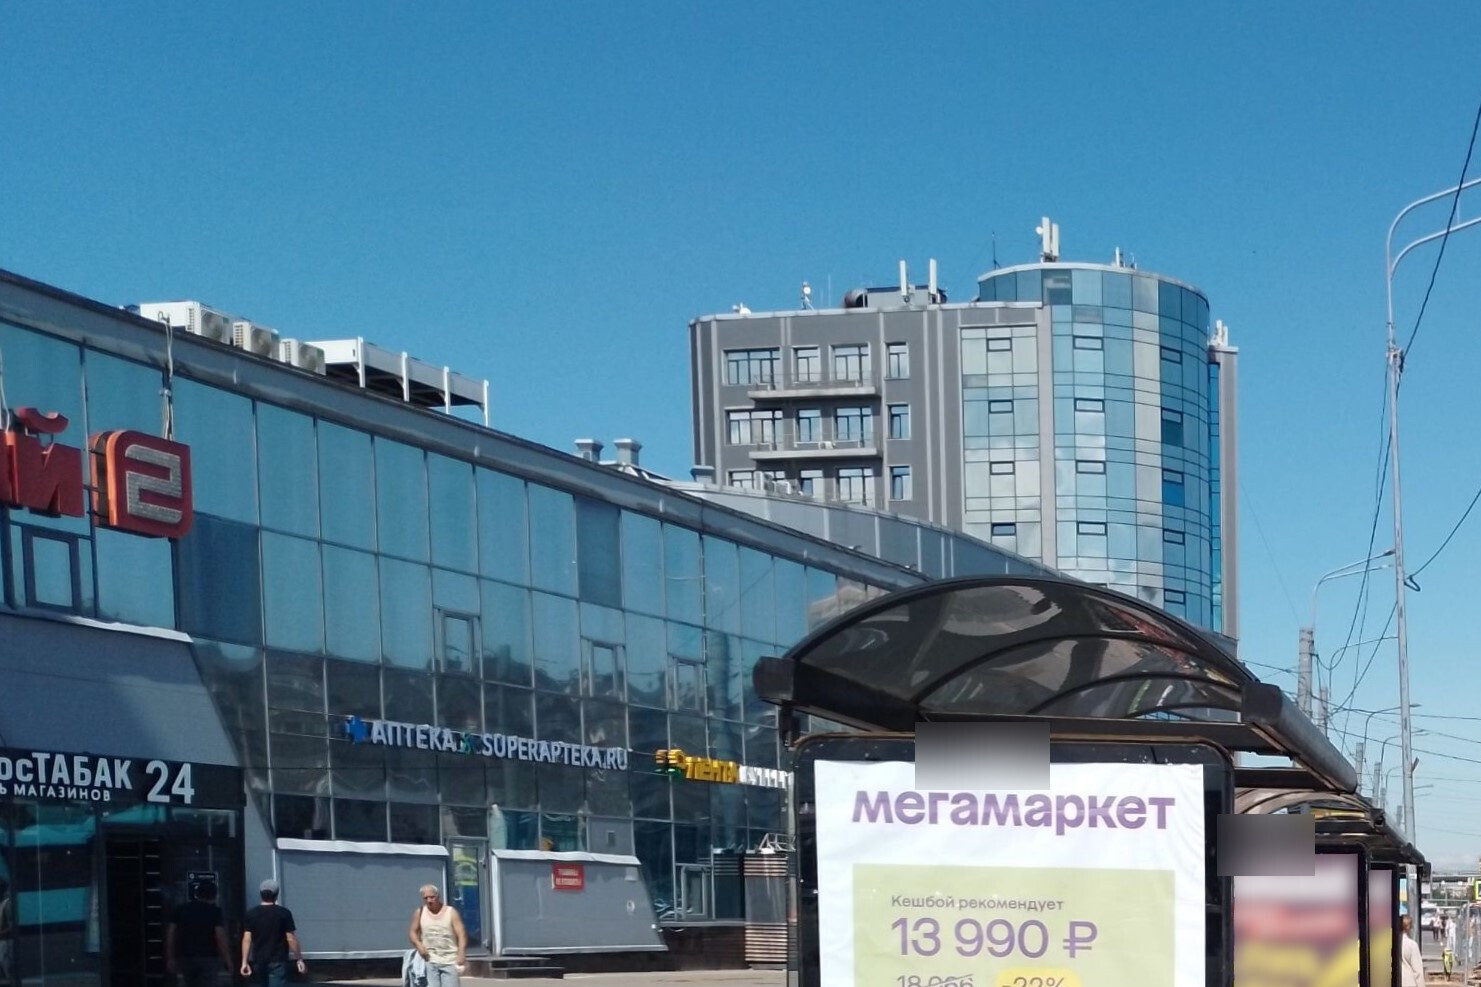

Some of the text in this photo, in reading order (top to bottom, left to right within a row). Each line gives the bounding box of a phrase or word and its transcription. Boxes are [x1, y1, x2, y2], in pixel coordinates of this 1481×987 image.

[371, 720, 456, 752] АПТЕКА
[481, 733, 628, 771] SUPERAPTEKA.RU
[13, 783, 111, 801] МАГАЗИНОВ
[145, 760, 195, 804] 24
[851, 790, 1176, 836] мегамаркет
[891, 896, 1064, 911] Кешбой рекомендует
[891, 917, 1098, 958] 13 990 ₽
